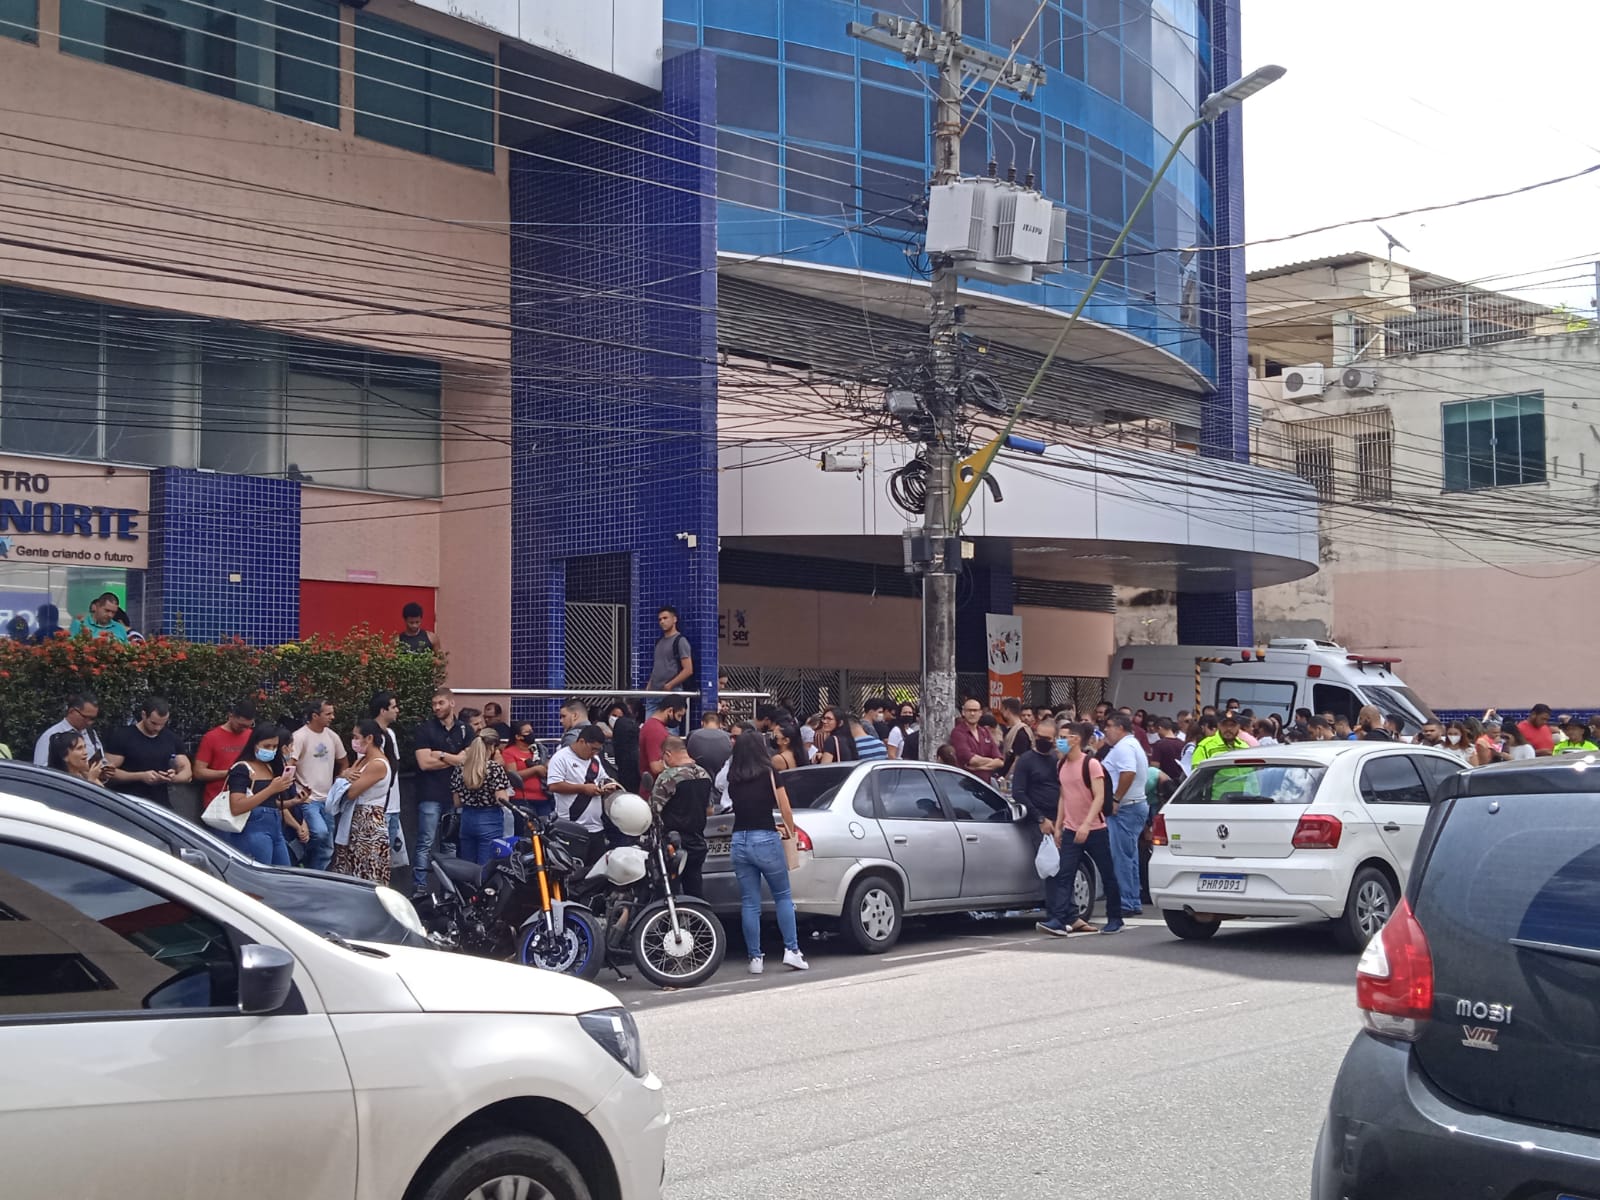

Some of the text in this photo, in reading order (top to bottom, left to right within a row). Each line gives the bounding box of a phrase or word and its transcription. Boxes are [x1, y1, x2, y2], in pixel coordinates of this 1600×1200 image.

[0, 469, 50, 494] TRO
[0, 499, 140, 542] NORTE
[16, 545, 50, 558] Gente
[52, 548, 92, 561] criando
[104, 551, 134, 562] futuro
[732, 630, 749, 641] ser
[1143, 691, 1174, 702] UTI
